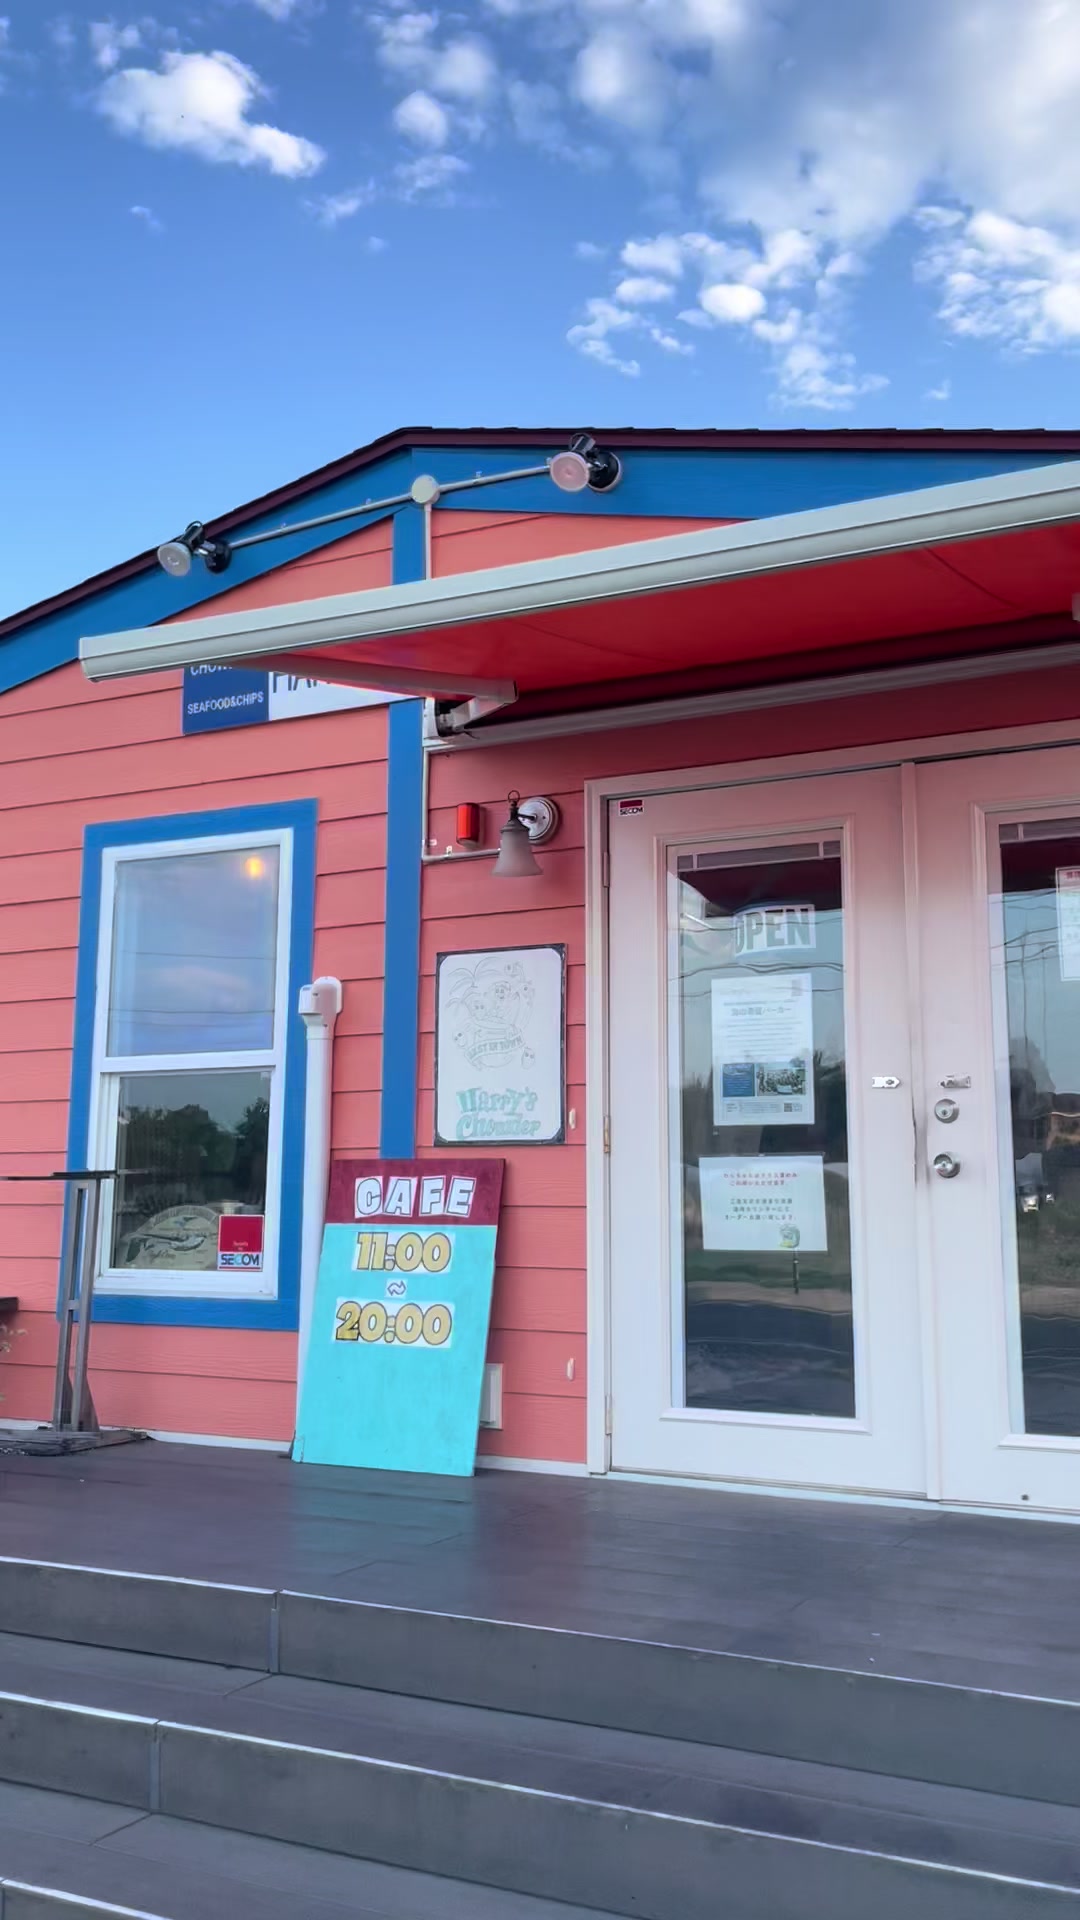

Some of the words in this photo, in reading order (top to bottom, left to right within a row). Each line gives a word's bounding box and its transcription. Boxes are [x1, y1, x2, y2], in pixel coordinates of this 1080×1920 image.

[186, 691, 264, 715] SEAFOOD&CHIPS
[455, 1086, 538, 1117] Harry's
[356, 1177, 475, 1216] CAFE
[221, 1253, 260, 1266] SECOM
[357, 1231, 452, 1273] 11:00
[333, 1300, 452, 1346] 20:00
